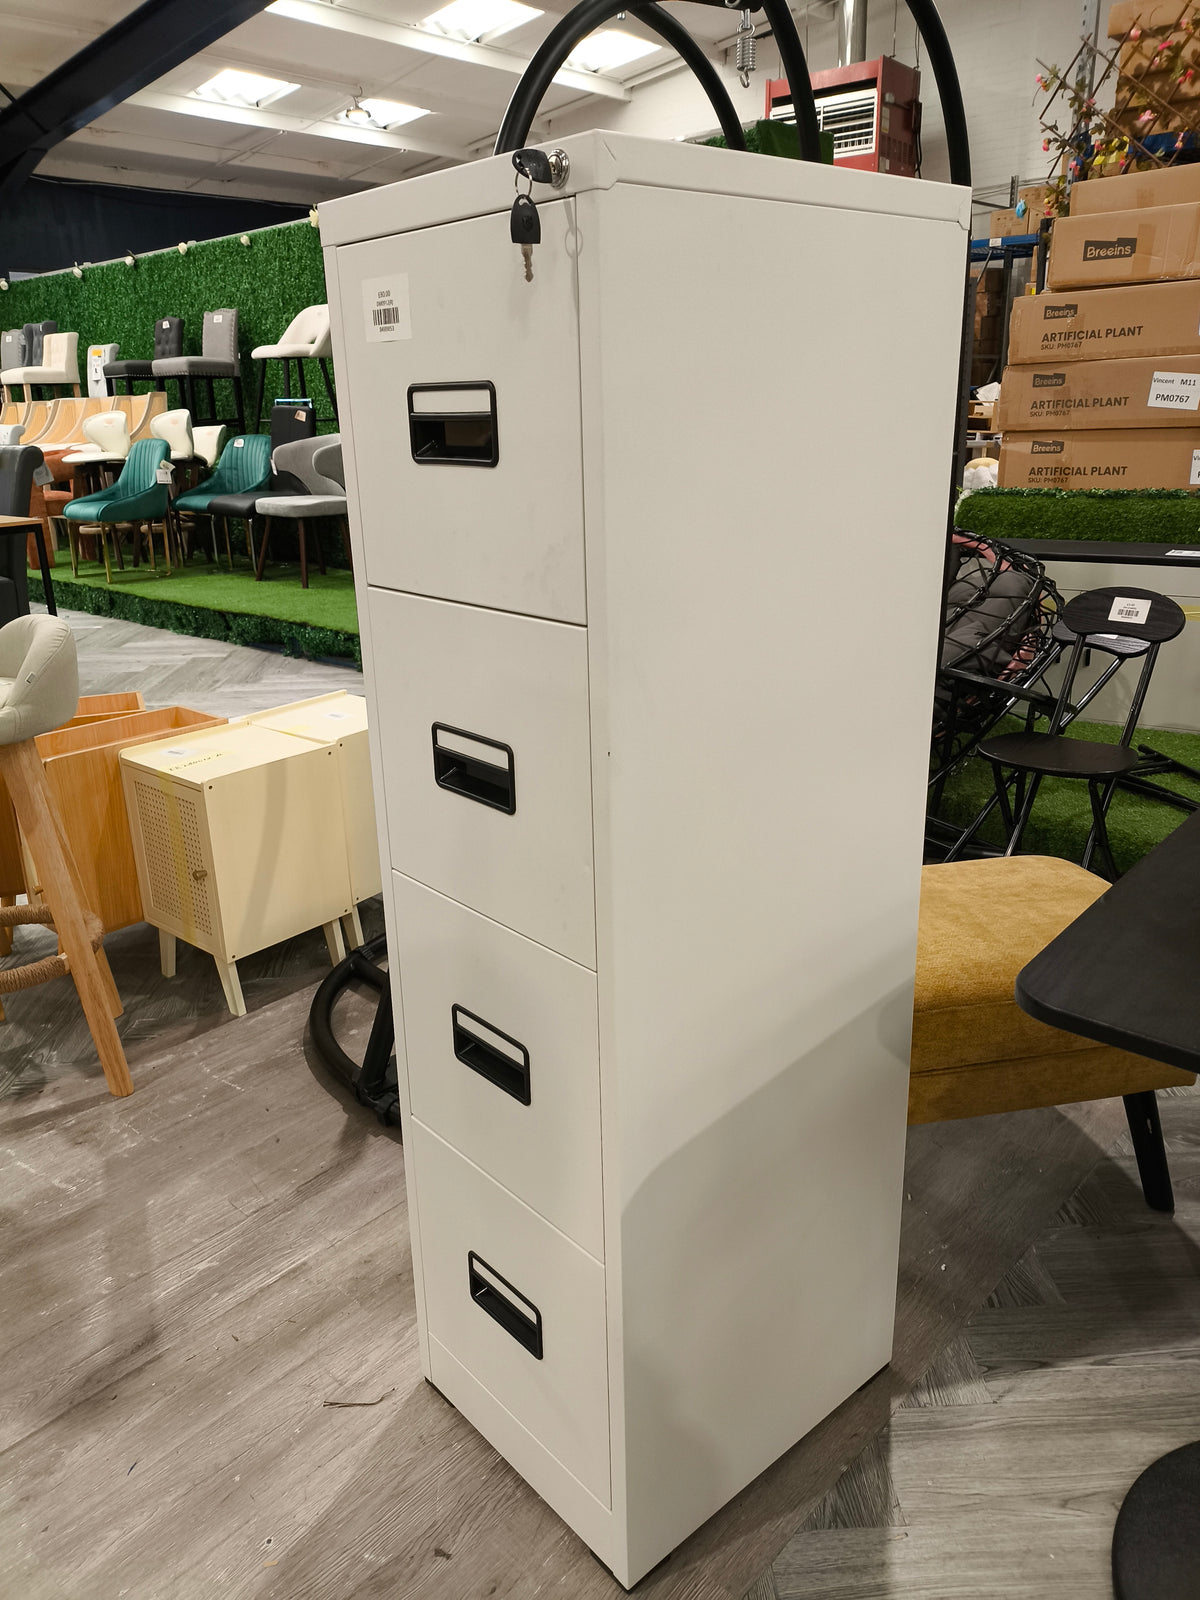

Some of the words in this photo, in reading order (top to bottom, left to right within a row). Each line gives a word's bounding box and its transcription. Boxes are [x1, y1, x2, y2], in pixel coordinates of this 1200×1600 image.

[1086, 244, 1131, 258] Breeins
[1046, 308, 1075, 318] Breeins
[1041, 329, 1103, 342] ARTIFICIAL
[1105, 325, 1143, 339] PLANT
[1041, 343, 1056, 351] SKU:
[1057, 341, 1082, 349] PM0767
[1034, 377, 1063, 386] Breeins
[1153, 376, 1175, 385] Vincent
[1180, 378, 1197, 387] M11
[1030, 399, 1089, 410] ARTIFICIAL
[1091, 396, 1129, 408] PLANT
[1155, 393, 1190, 404] PM0767
[1032, 444, 1061, 453] Breeins
[1028, 467, 1088, 477] ARTIFICIAL
[1090, 466, 1128, 476] PLANT
